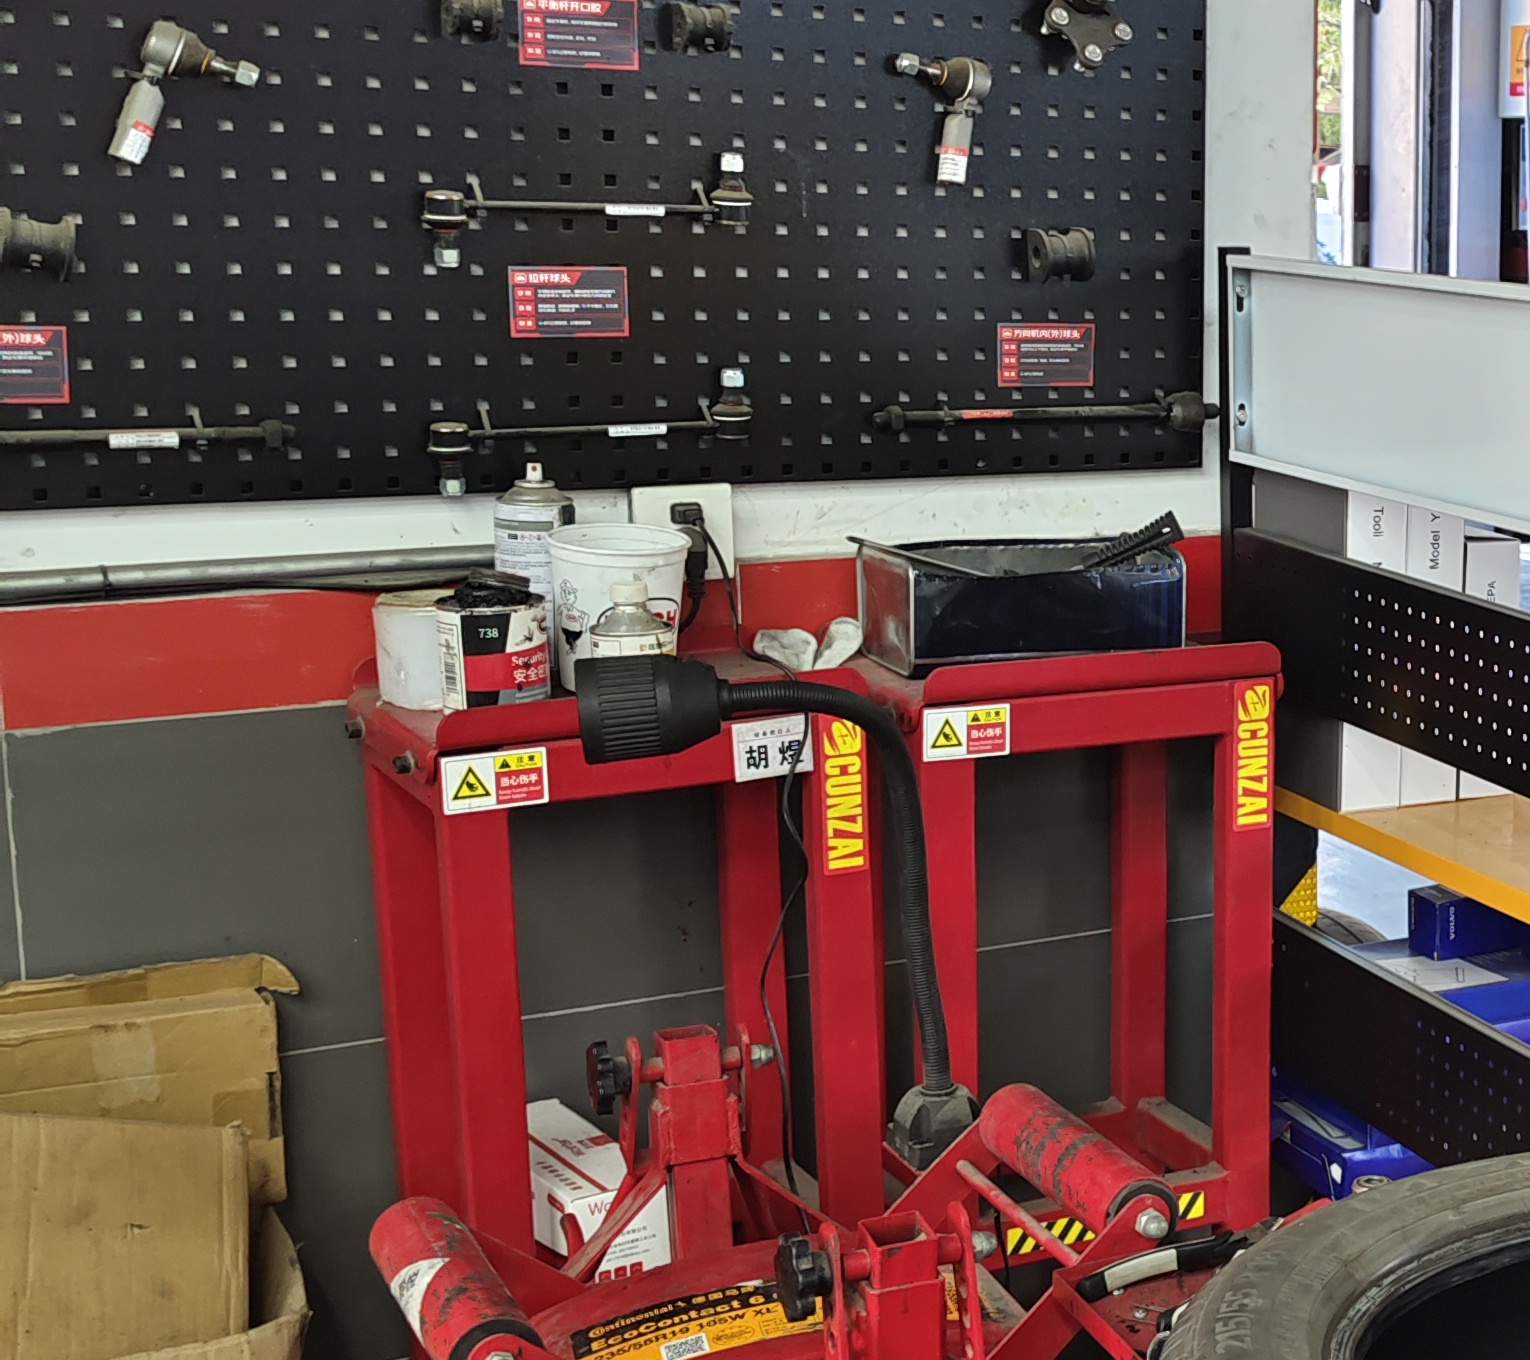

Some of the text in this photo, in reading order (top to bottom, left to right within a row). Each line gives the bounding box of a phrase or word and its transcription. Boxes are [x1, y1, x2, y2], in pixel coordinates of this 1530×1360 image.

[478, 627, 499, 639] 738
[500, 774, 540, 787] 当心伤手
[1236, 718, 1269, 826] CUNZAI
[825, 753, 867, 871] CUNZAI
[589, 1296, 742, 1354] EcoContact
